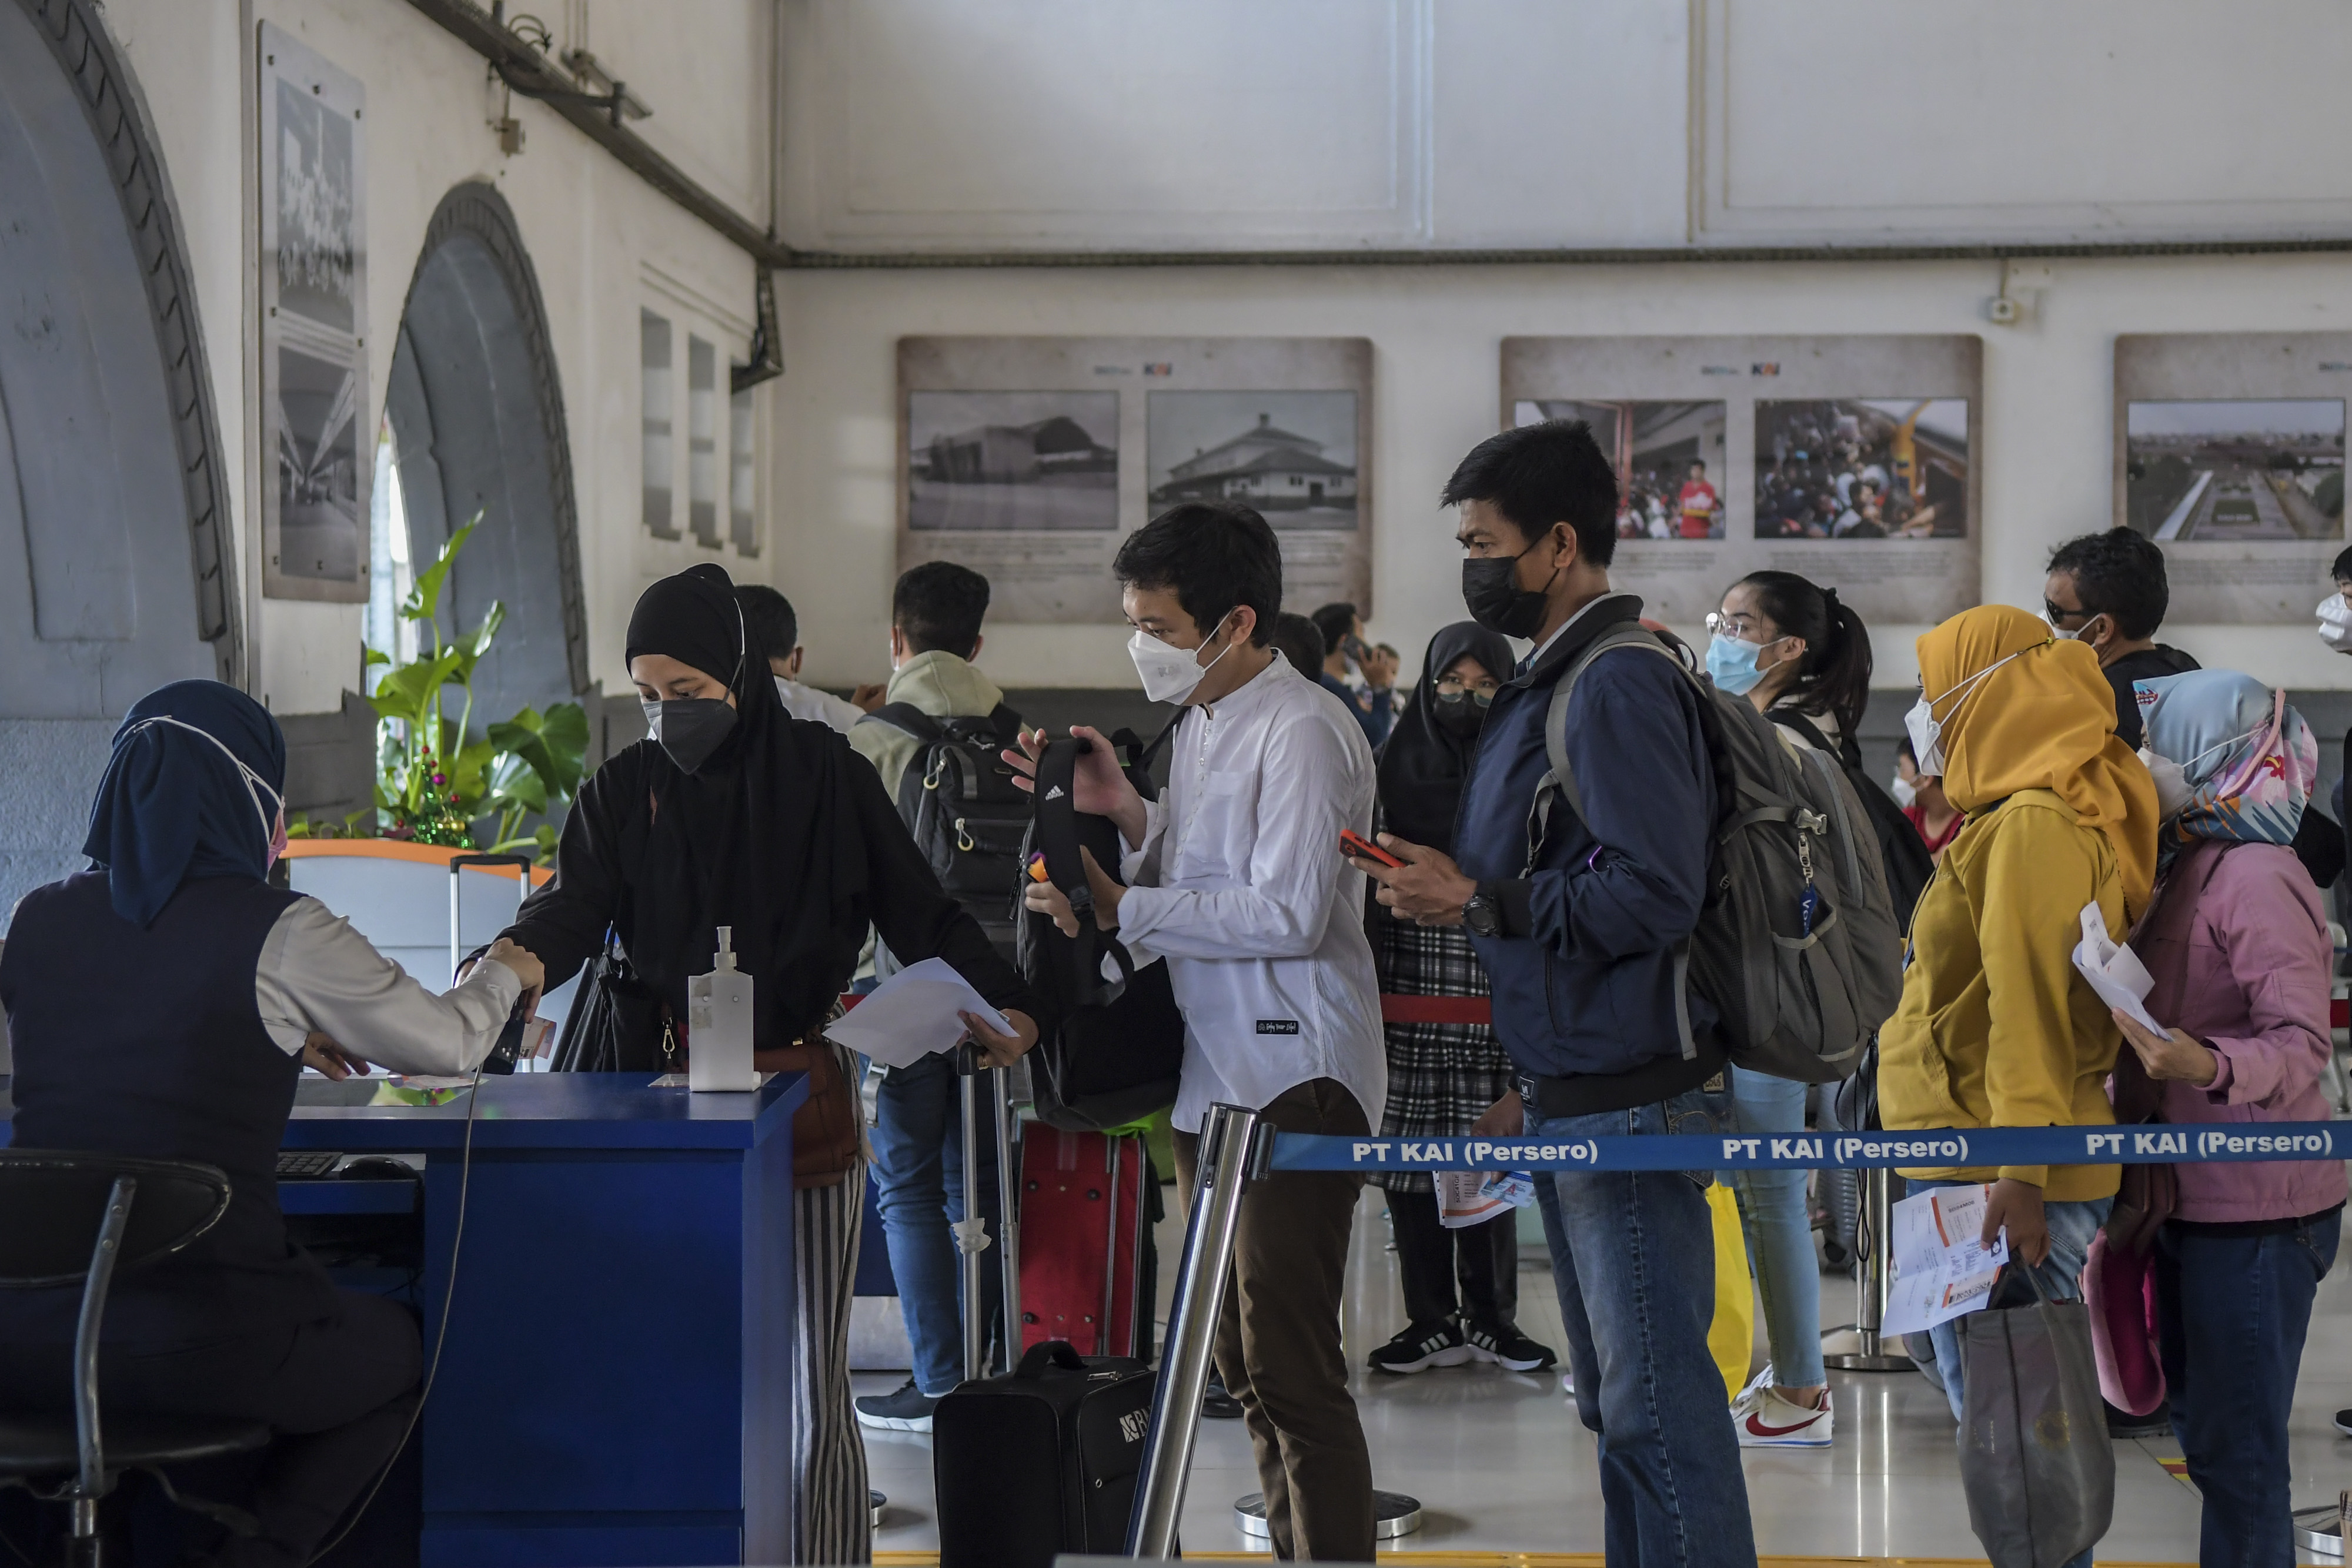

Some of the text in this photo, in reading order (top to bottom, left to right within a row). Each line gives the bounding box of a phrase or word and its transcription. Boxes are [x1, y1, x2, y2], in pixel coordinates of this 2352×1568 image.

[1353, 1139, 1598, 1166] PT KAI (Persero)
[1723, 1135, 1968, 1164] PT KAI (Persero)
[2086, 1130, 2333, 1157] PT KAI (Persero)
